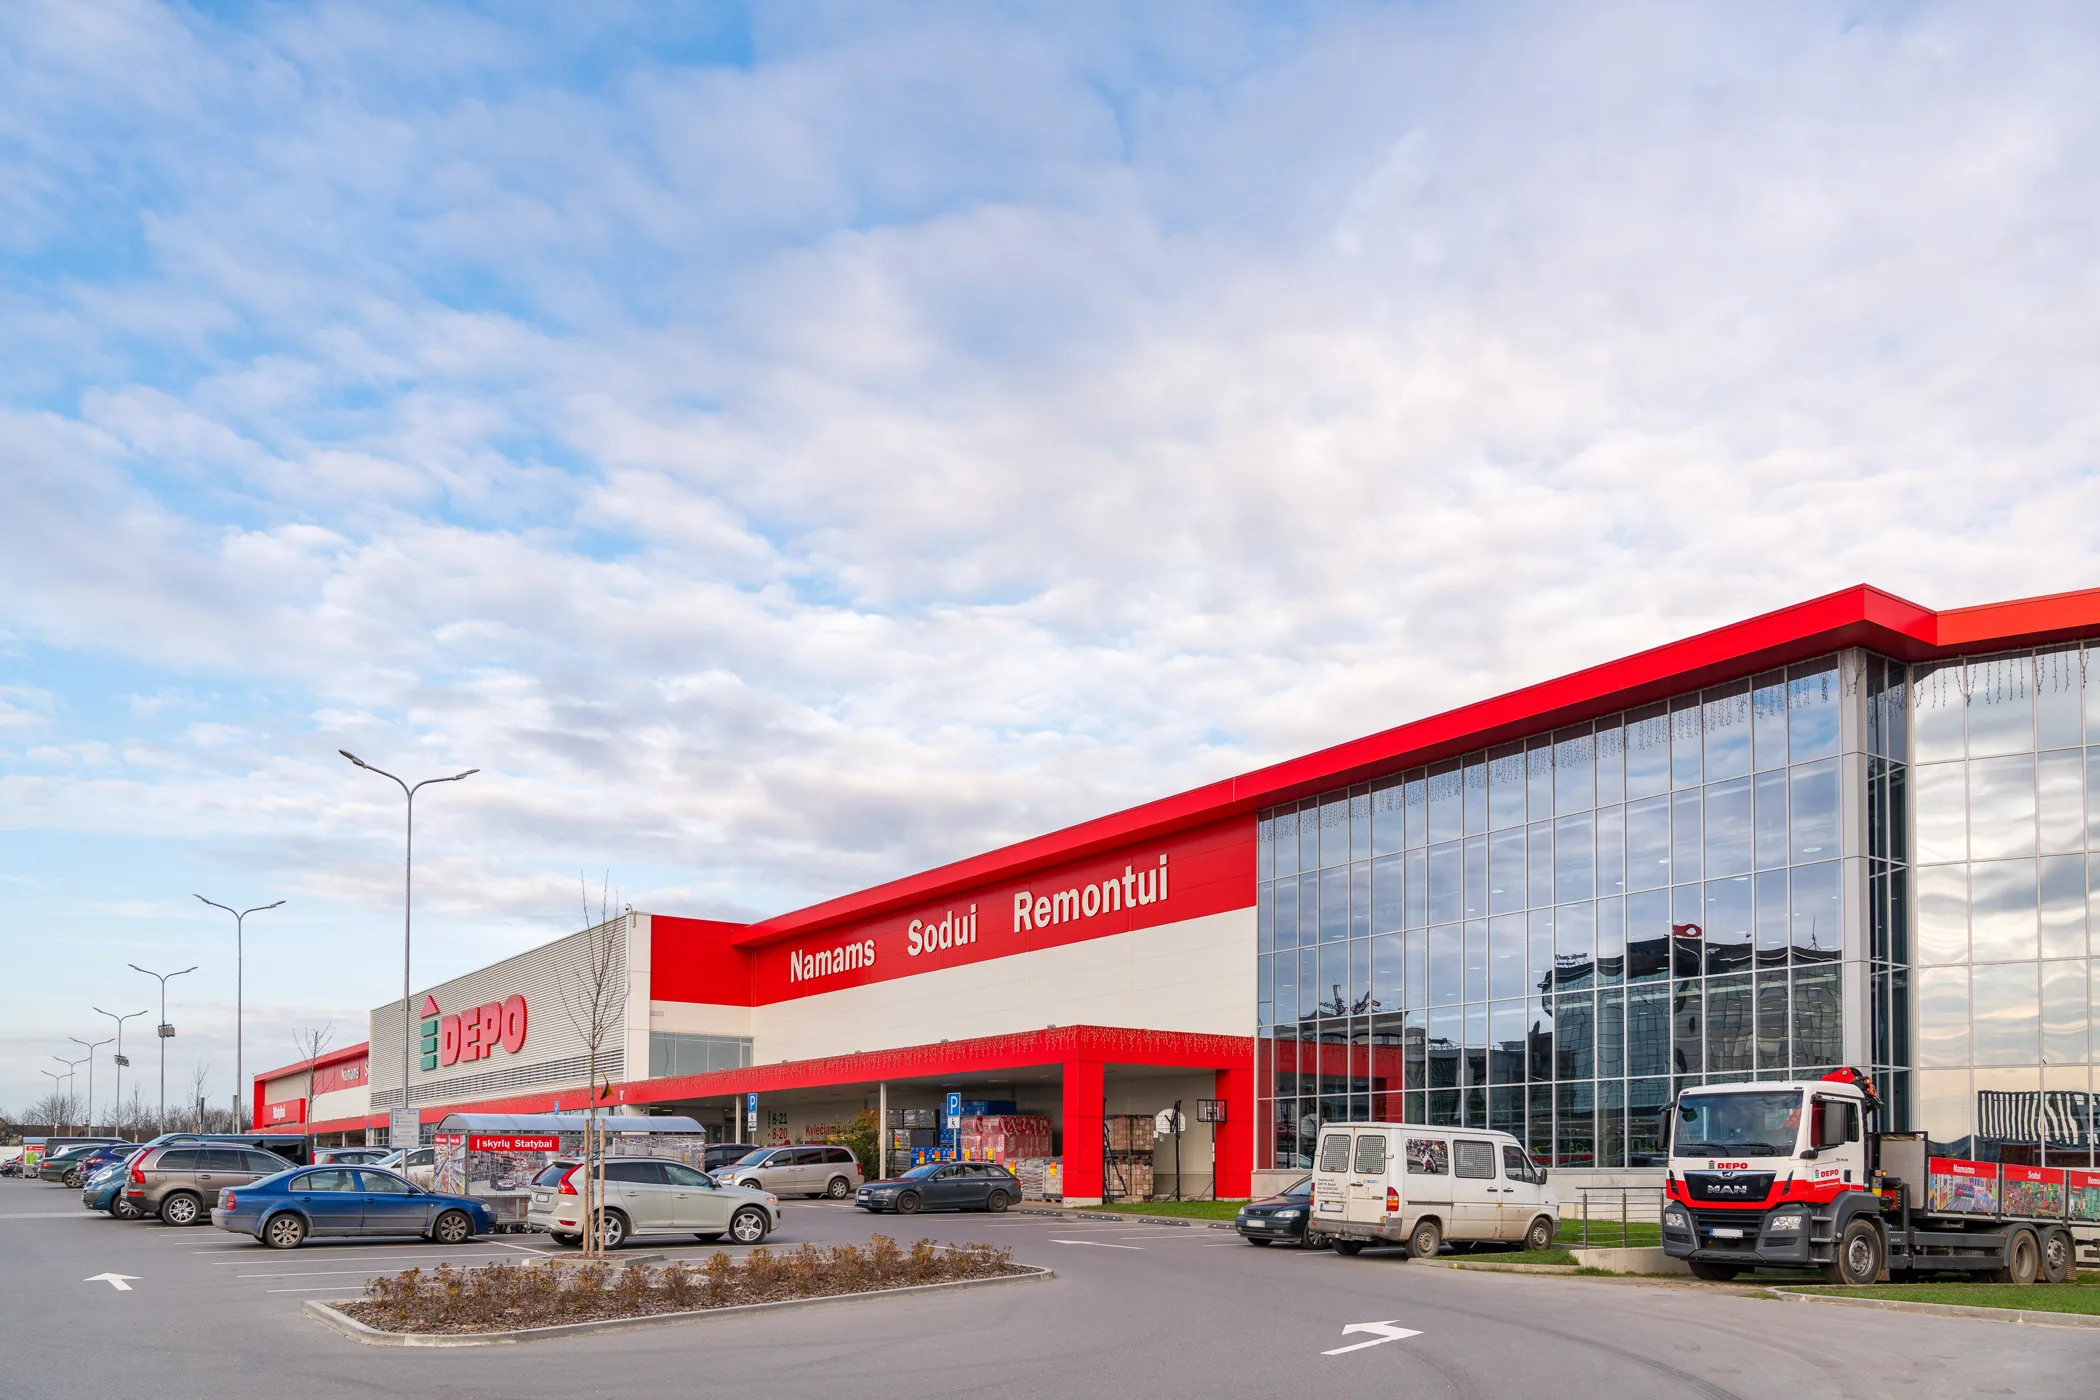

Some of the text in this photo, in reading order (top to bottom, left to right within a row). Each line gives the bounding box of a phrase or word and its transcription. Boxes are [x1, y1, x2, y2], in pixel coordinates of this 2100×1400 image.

[790, 853, 1168, 984] Namams Sodui Remontui
[440, 994, 528, 1068] DEPO
[950, 1096, 958, 1114] P
[772, 1112, 788, 1125] 8-21
[772, 1128, 788, 1140] 8-20
[482, 1139, 510, 1149] skyrių
[514, 1139, 552, 1149] Statybai
[1717, 1162, 1748, 1170] DEPO
[1953, 1163, 1975, 1175] Namams
[1820, 1169, 1839, 1178] DEPO
[2027, 1170, 2042, 1180] Sodui
[1707, 1185, 1748, 1194] MAN
